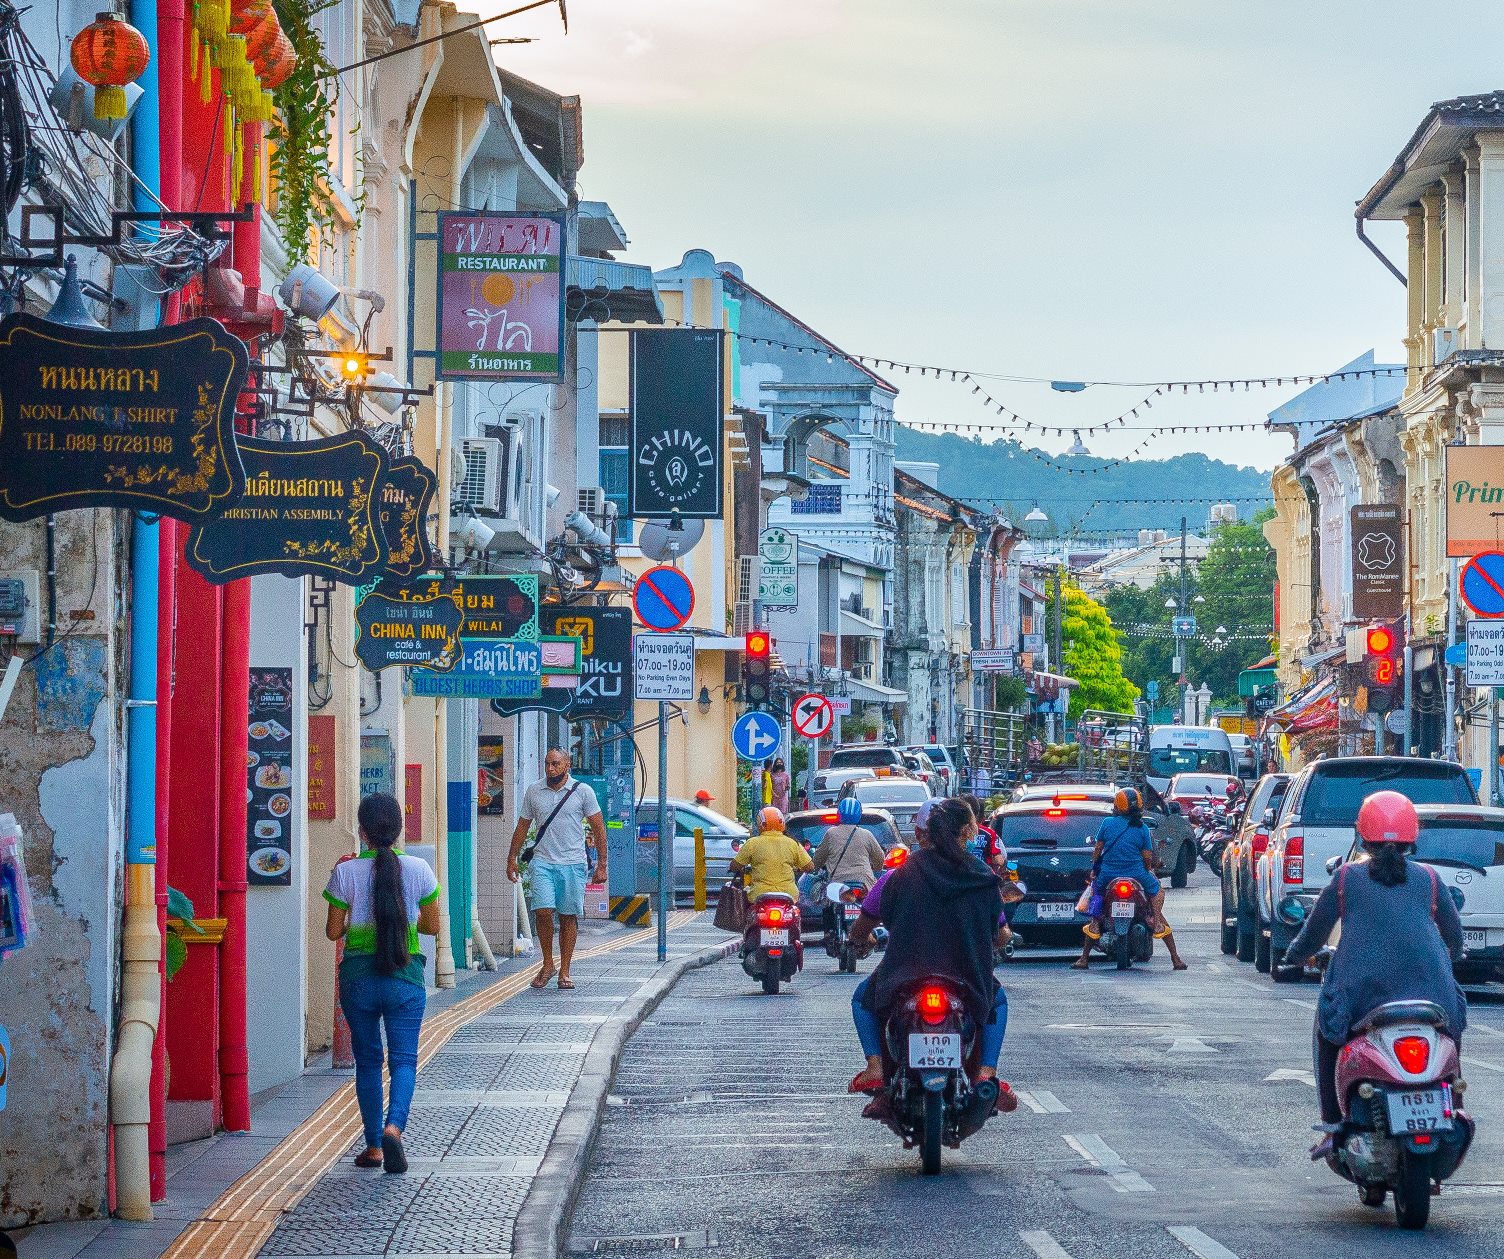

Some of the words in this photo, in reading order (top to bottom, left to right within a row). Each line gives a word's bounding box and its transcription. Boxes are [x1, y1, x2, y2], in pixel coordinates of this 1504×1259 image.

[457, 256, 547, 271] RESTAURANT
[468, 353, 532, 371] ร้านอาหาร
[20, 404, 105, 421] NONLANG
[127, 407, 179, 424] SHIRT
[639, 429, 714, 466] CHINO
[282, 508, 345, 521] ASSEMBLY
[370, 623, 415, 639] CHINA
[421, 624, 448, 640] INN
[468, 621, 503, 632] WILAI
[415, 640, 422, 650] &
[386, 650, 431, 661] restaurant
[637, 658, 692, 671] 07.00-19.00
[1378, 660, 1392, 681] 2
[1476, 660, 1493, 669] Parking
[646, 674, 665, 683] Parking
[666, 674, 678, 682] Even
[505, 680, 538, 695] SHOP
[1055, 903, 1074, 912] 2437
[922, 1036, 952, 1046] 1กด
[917, 1056, 956, 1067] 4567
[1405, 1116, 1438, 1131] 897
